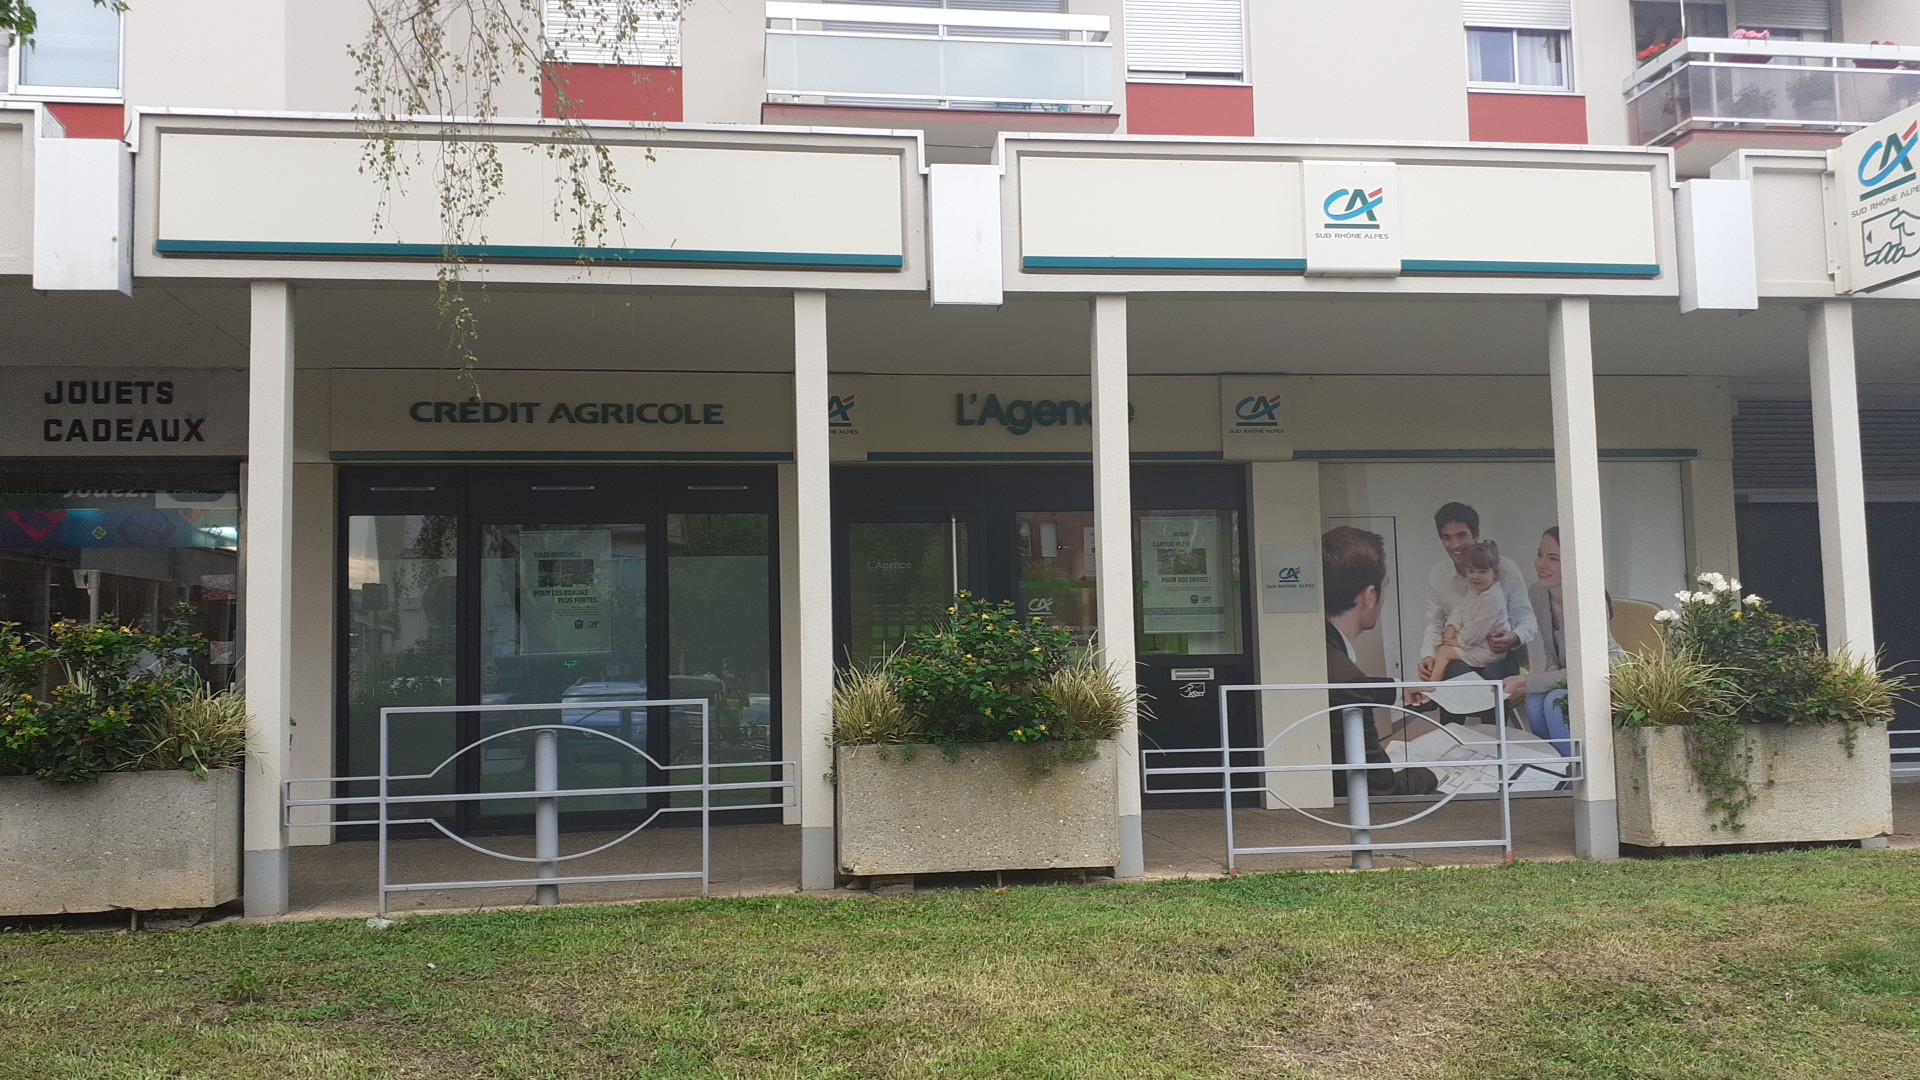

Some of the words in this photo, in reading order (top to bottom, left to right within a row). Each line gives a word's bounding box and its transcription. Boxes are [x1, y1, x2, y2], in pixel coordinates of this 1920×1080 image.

[1850, 206, 1868, 218] SUD
[1869, 194, 1898, 211] RHÔNE
[1900, 184, 1920, 199] ALPE
[1334, 231, 1362, 239] RHÔNE
[44, 380, 174, 405] JOUETS
[409, 397, 541, 424] CRÉDIT
[547, 402, 724, 425] AGRICOLE
[956, 393, 1135, 435] L'Agen
[43, 418, 205, 442] CADEAUX
[867, 561, 912, 571] L'Agence
